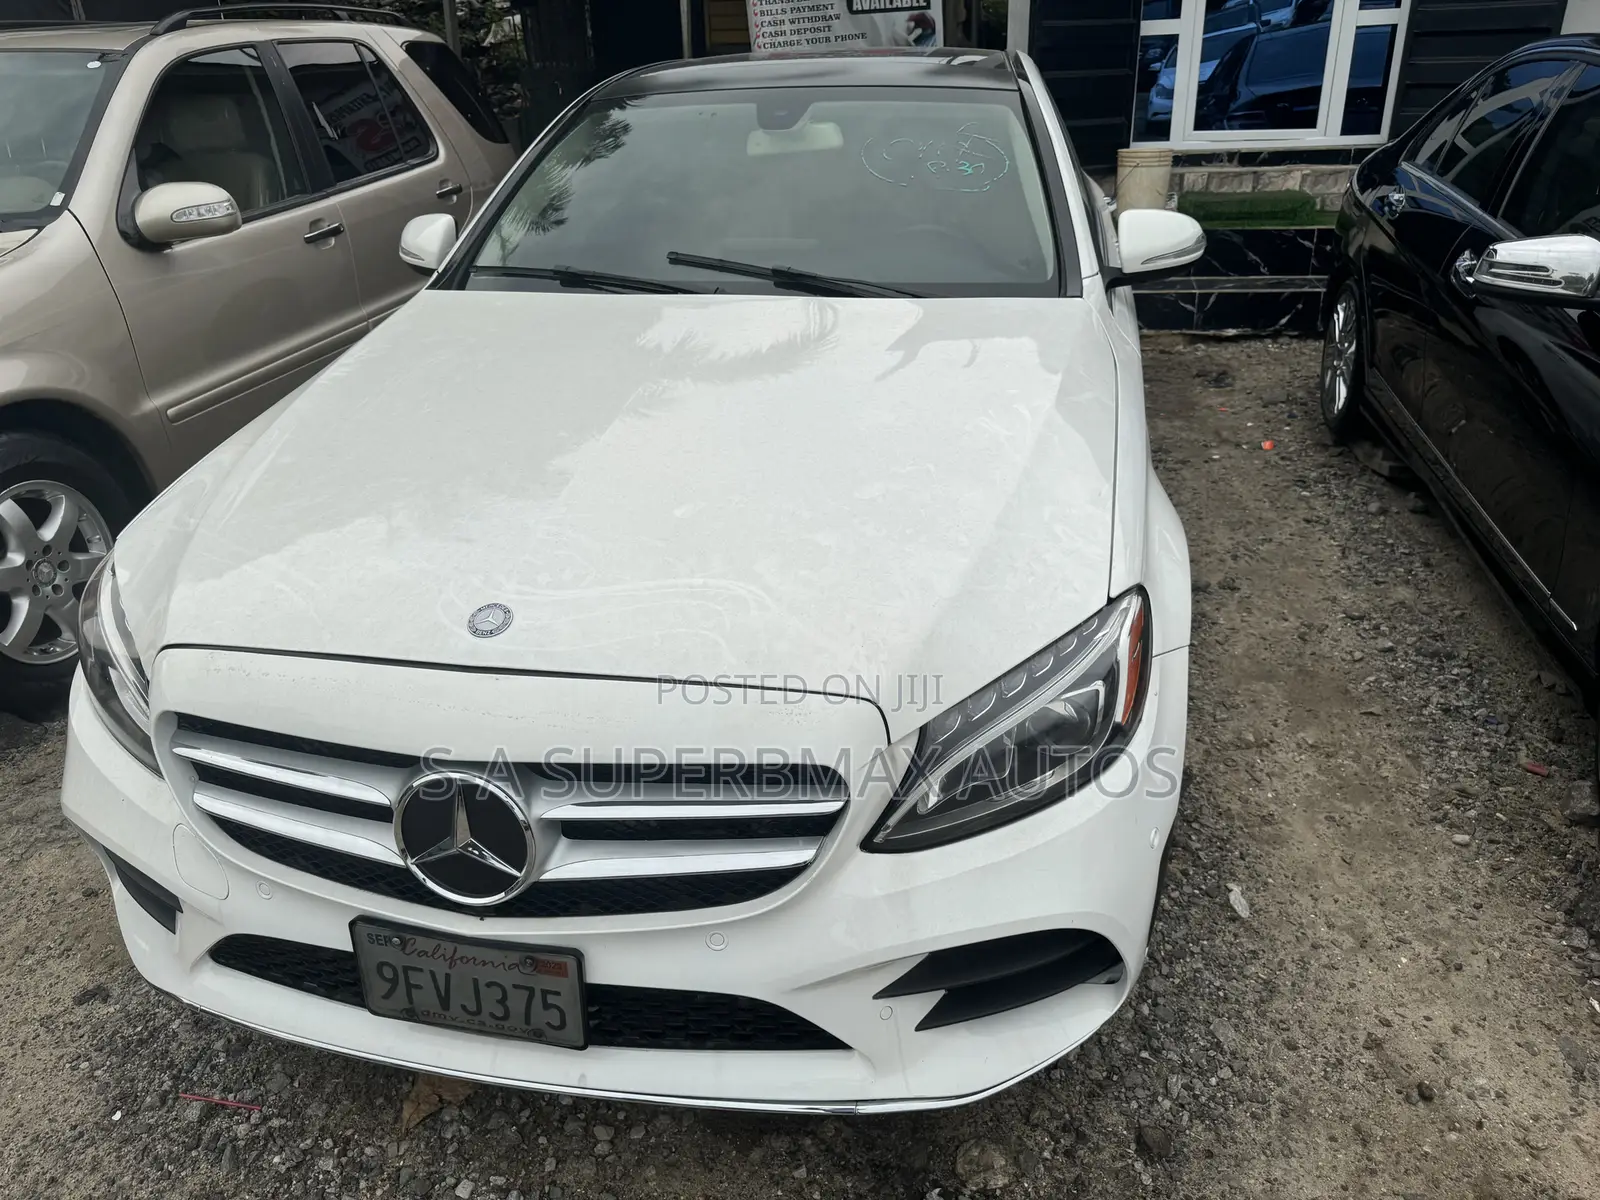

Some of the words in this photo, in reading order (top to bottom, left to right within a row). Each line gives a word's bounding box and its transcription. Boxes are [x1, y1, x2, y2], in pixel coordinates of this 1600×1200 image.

[760, 8, 787, 17] BILLS
[790, 3, 835, 14] PAYMENT
[761, 19, 785, 28] CASH
[788, 13, 841, 25] WITHDRAW
[762, 30, 787, 39] CASH
[790, 25, 832, 36] DEPOSIT
[763, 39, 803, 49] CHARGE
[805, 36, 831, 45] YOUR
[834, 32, 868, 43] PHONE
[402, 937, 526, 974] California
[376, 960, 568, 1032] 9FVJ375
[420, 1009, 528, 1034] dmv.ca.gov
